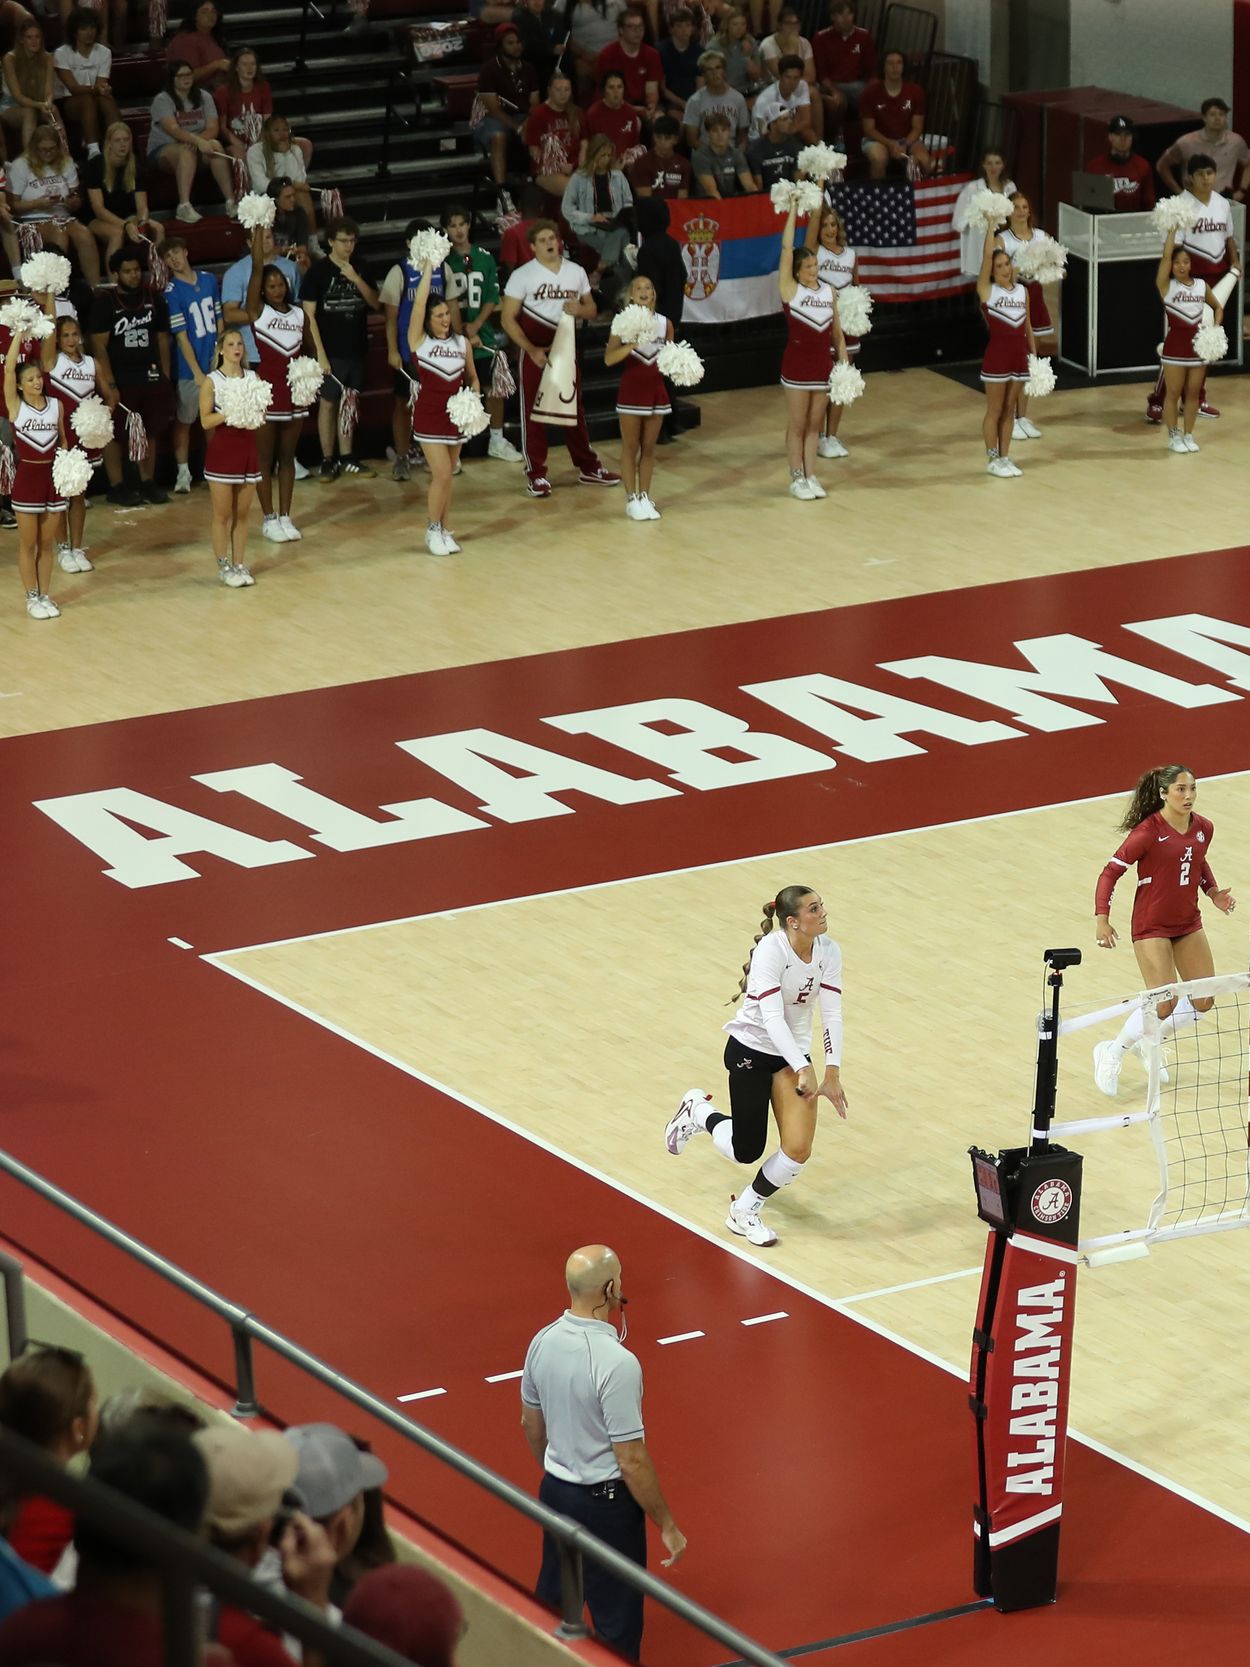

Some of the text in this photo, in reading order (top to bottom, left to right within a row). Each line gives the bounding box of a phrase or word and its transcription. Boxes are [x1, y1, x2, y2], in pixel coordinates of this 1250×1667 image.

[188, 296, 217, 339] 16
[124, 328, 150, 348] 23
[1180, 846, 1193, 861] A
[1179, 862, 1191, 886] 2
[798, 976, 815, 992] A
[1042, 1191, 1060, 1211] A
[1005, 1278, 1066, 1496] ALABAMA
